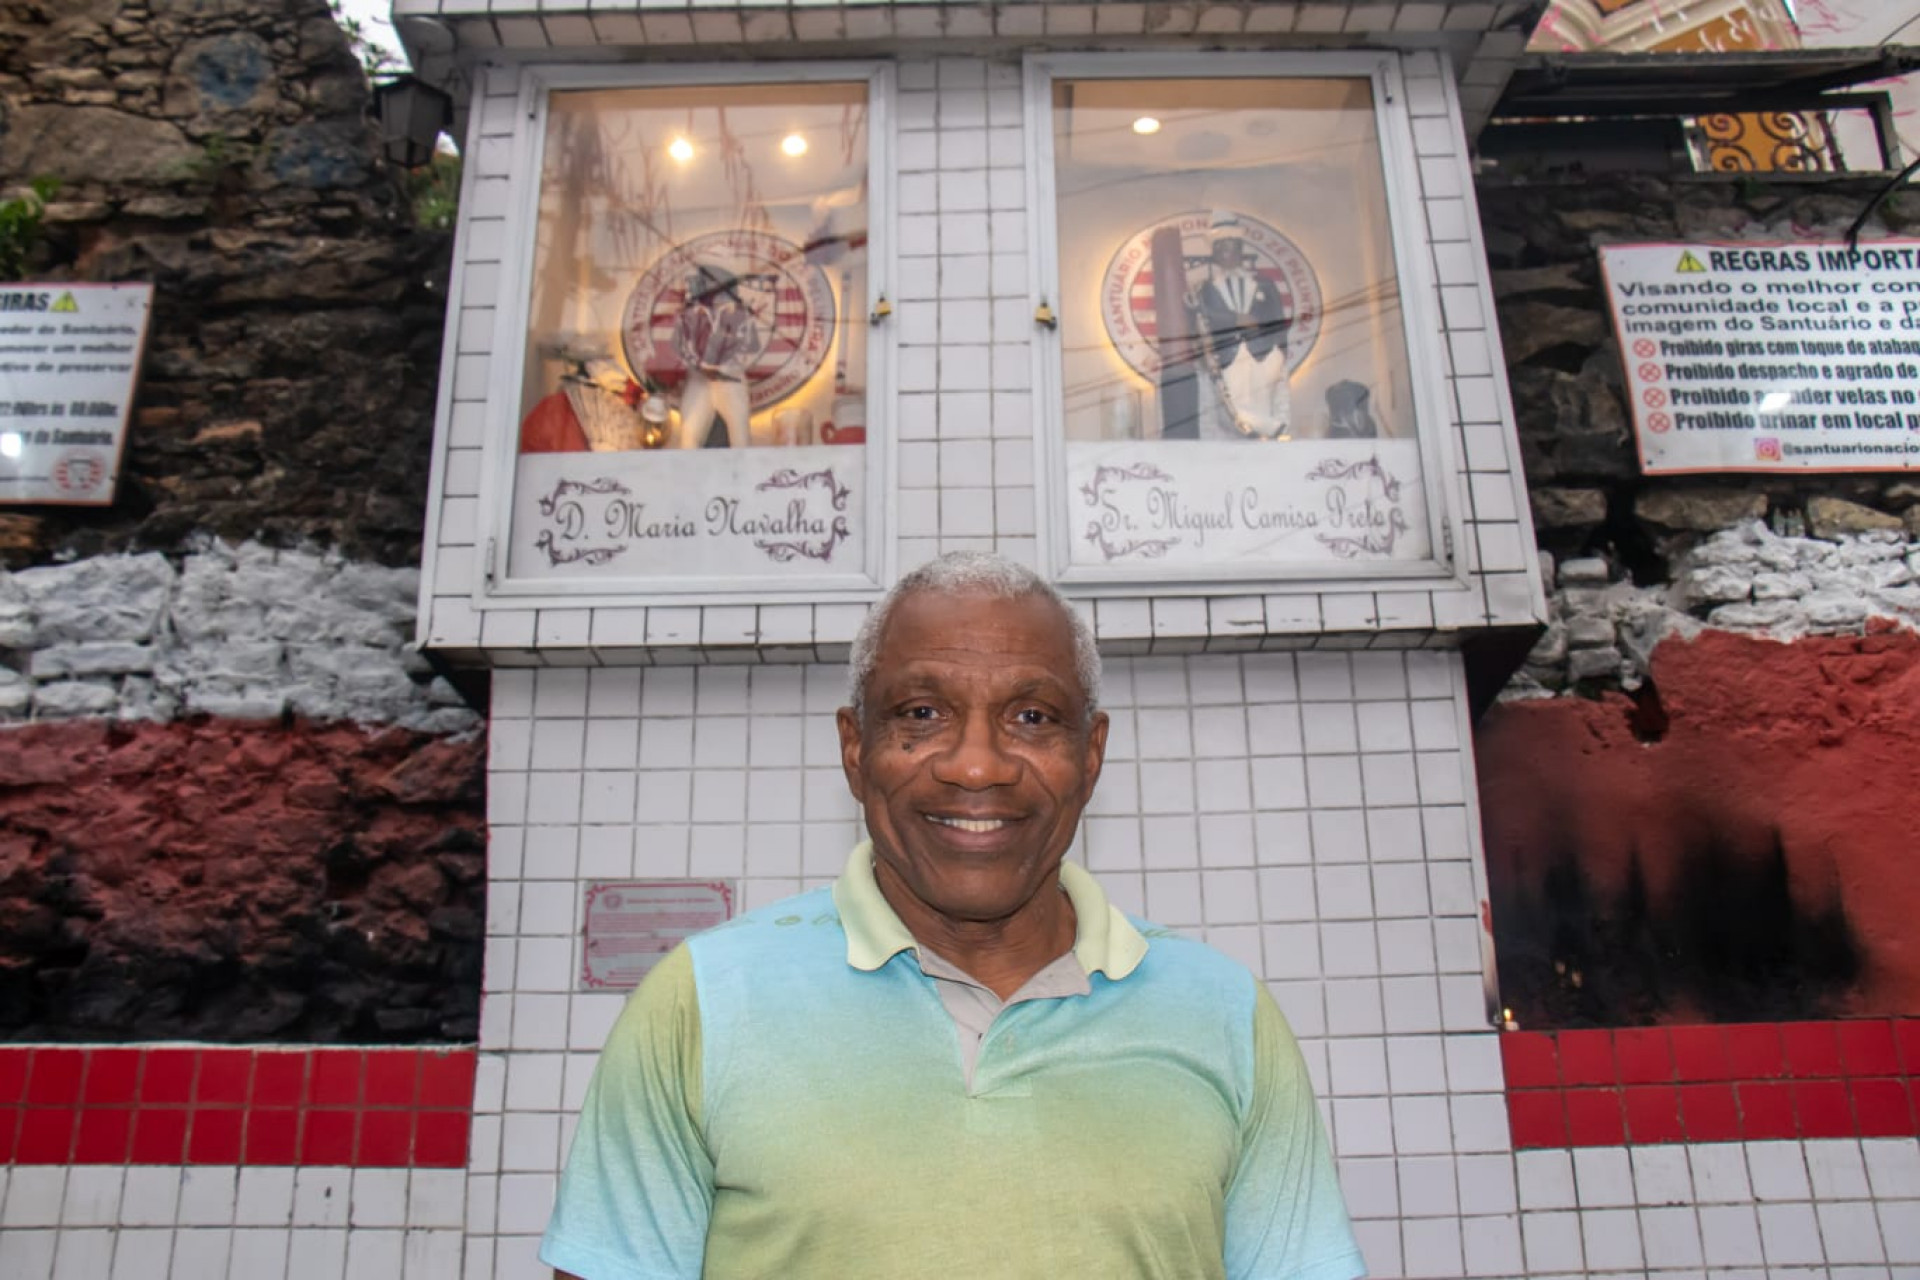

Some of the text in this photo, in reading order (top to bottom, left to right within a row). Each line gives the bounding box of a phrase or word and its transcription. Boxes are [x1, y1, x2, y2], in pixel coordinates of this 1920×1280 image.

[1709, 250, 1811, 271] REGRAS
[1618, 279, 1732, 297] Visando
[1741, 282, 1757, 295] o
[1766, 279, 1861, 295] melhor
[1622, 298, 1779, 316] comunidade
[1787, 298, 1848, 314] local
[1857, 301, 1871, 313] e
[1879, 301, 1893, 313] a
[1625, 316, 1717, 335] imagem
[1724, 315, 1755, 331] do
[1760, 314, 1872, 331] Santuário
[1878, 318, 1892, 331] e
[1660, 338, 1724, 356] Proibido
[1725, 339, 1765, 358] giras
[1766, 341, 1799, 356] com
[1801, 339, 1844, 357] toque
[1846, 339, 1867, 356] de
[1665, 362, 1918, 381] Proibido despacho e agrado de
[1670, 386, 1751, 405] Proibido
[1835, 387, 1888, 405] velas
[1890, 389, 1916, 405] no
[1674, 411, 1757, 430] Proibido
[1759, 411, 1817, 429] urinar
[1821, 413, 1853, 430] em
[1853, 410, 1904, 430] local
[555, 496, 826, 541] D. Maria Navalha
[1102, 484, 1387, 548] Sr. Miguel Camisa Preto
